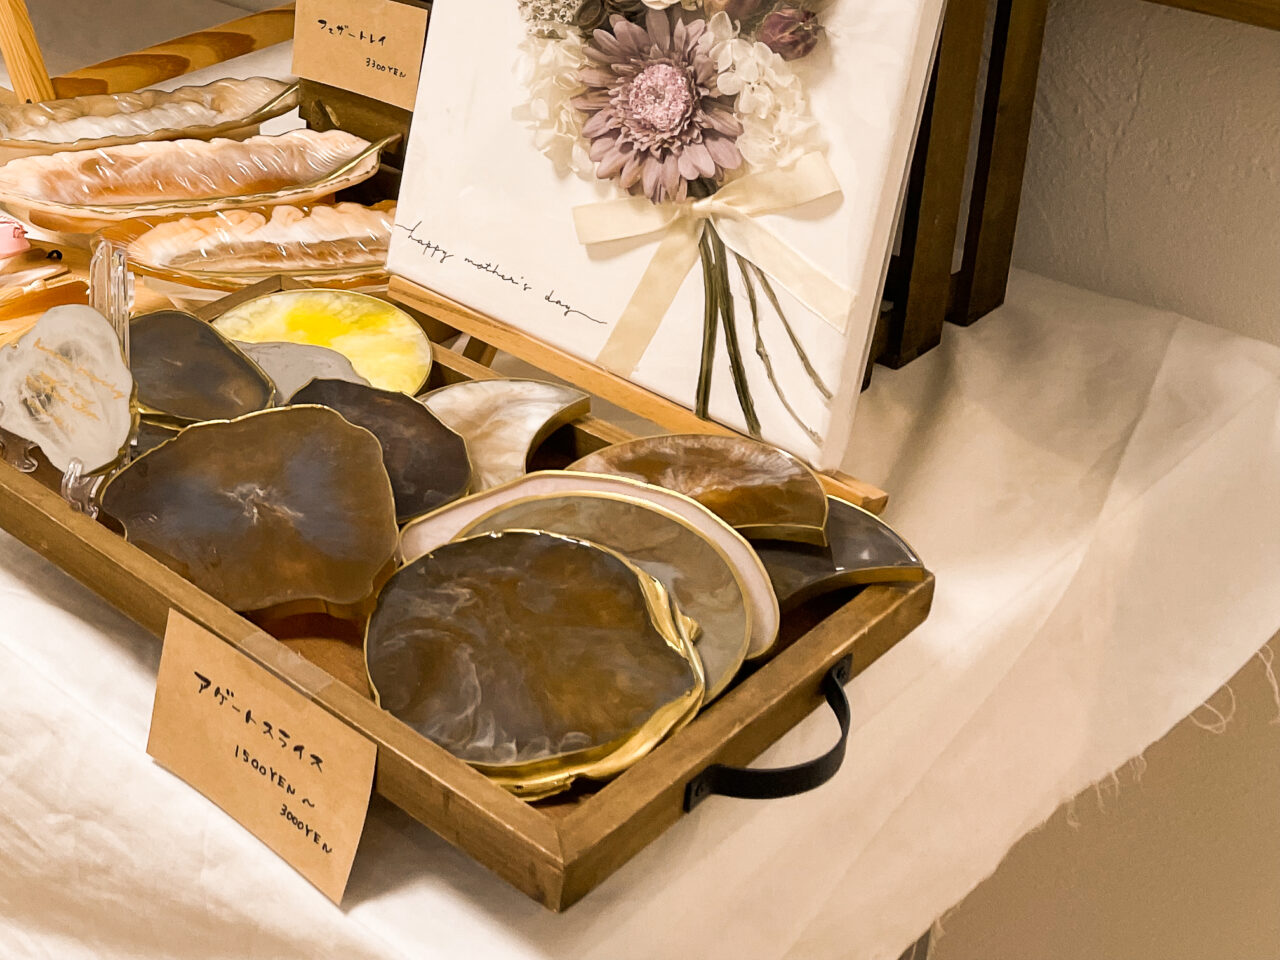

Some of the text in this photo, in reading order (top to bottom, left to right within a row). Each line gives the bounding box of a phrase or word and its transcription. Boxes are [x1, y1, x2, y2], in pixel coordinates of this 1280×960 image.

[317, 19, 387, 47] フェザートレイ
[365, 57, 407, 78] 3300YEN
[395, 220, 608, 325] happy mother's day
[193, 671, 324, 774] アゲートスライス
[279, 804, 333, 854] 3000YEN
